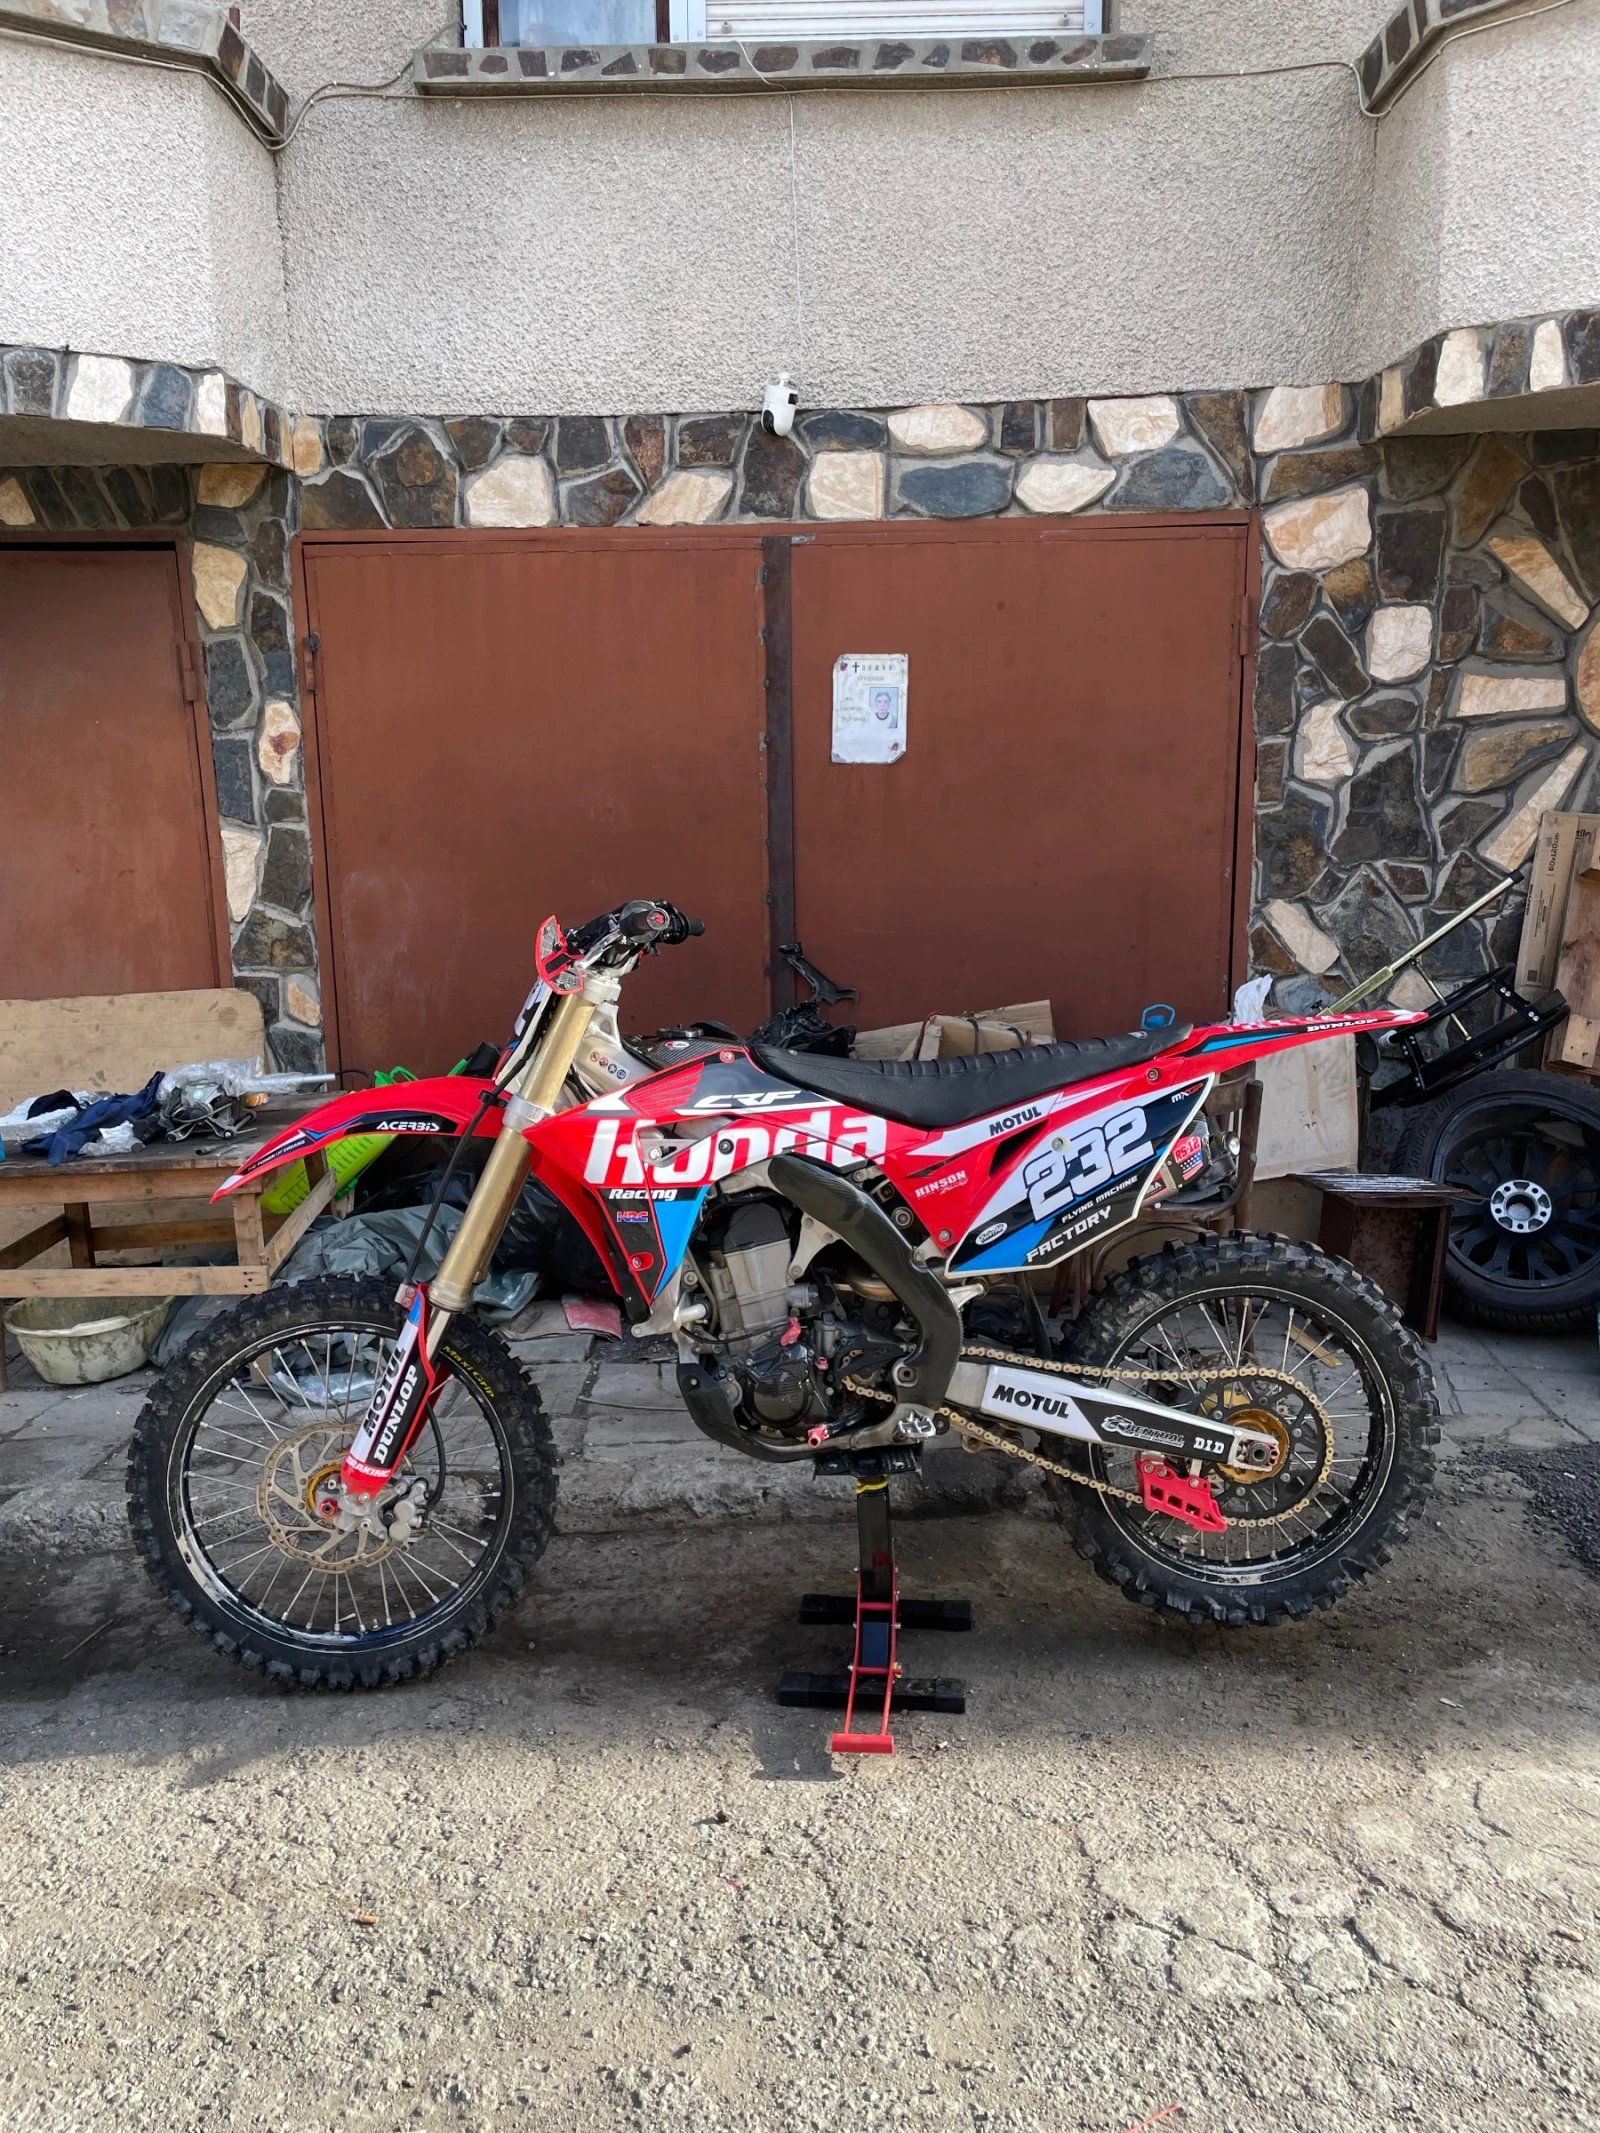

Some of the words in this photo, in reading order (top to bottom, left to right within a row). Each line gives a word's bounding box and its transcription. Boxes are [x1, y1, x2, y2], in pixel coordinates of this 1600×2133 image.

[1547, 832, 1560, 872] 60x120cm
[1306, 1018, 1378, 1032] DUNLOP
[694, 1090, 801, 1108] CRF
[376, 1120, 440, 1132] ACERBIS
[989, 1106, 1042, 1137] MOTUL
[1407, 1090, 1460, 1171] BRIDGESTONE
[583, 1110, 887, 1184] Honda
[1022, 1105, 1155, 1223] 232
[914, 1170, 967, 1198] HINSON
[1061, 1200, 1094, 1223] FLYING
[1095, 1174, 1138, 1204] MACHINE
[616, 1210, 649, 1223] HRC
[1025, 1205, 1111, 1263] FACTORY
[442, 1345, 474, 1371] Maxi
[362, 1347, 406, 1439] MOTUL
[992, 1384, 1070, 1420] MOTUL
[374, 1364, 418, 1464] DUNLOP
[1126, 1422, 1185, 1444] RENTHAL
[345, 1455, 391, 1478] BRAKING
